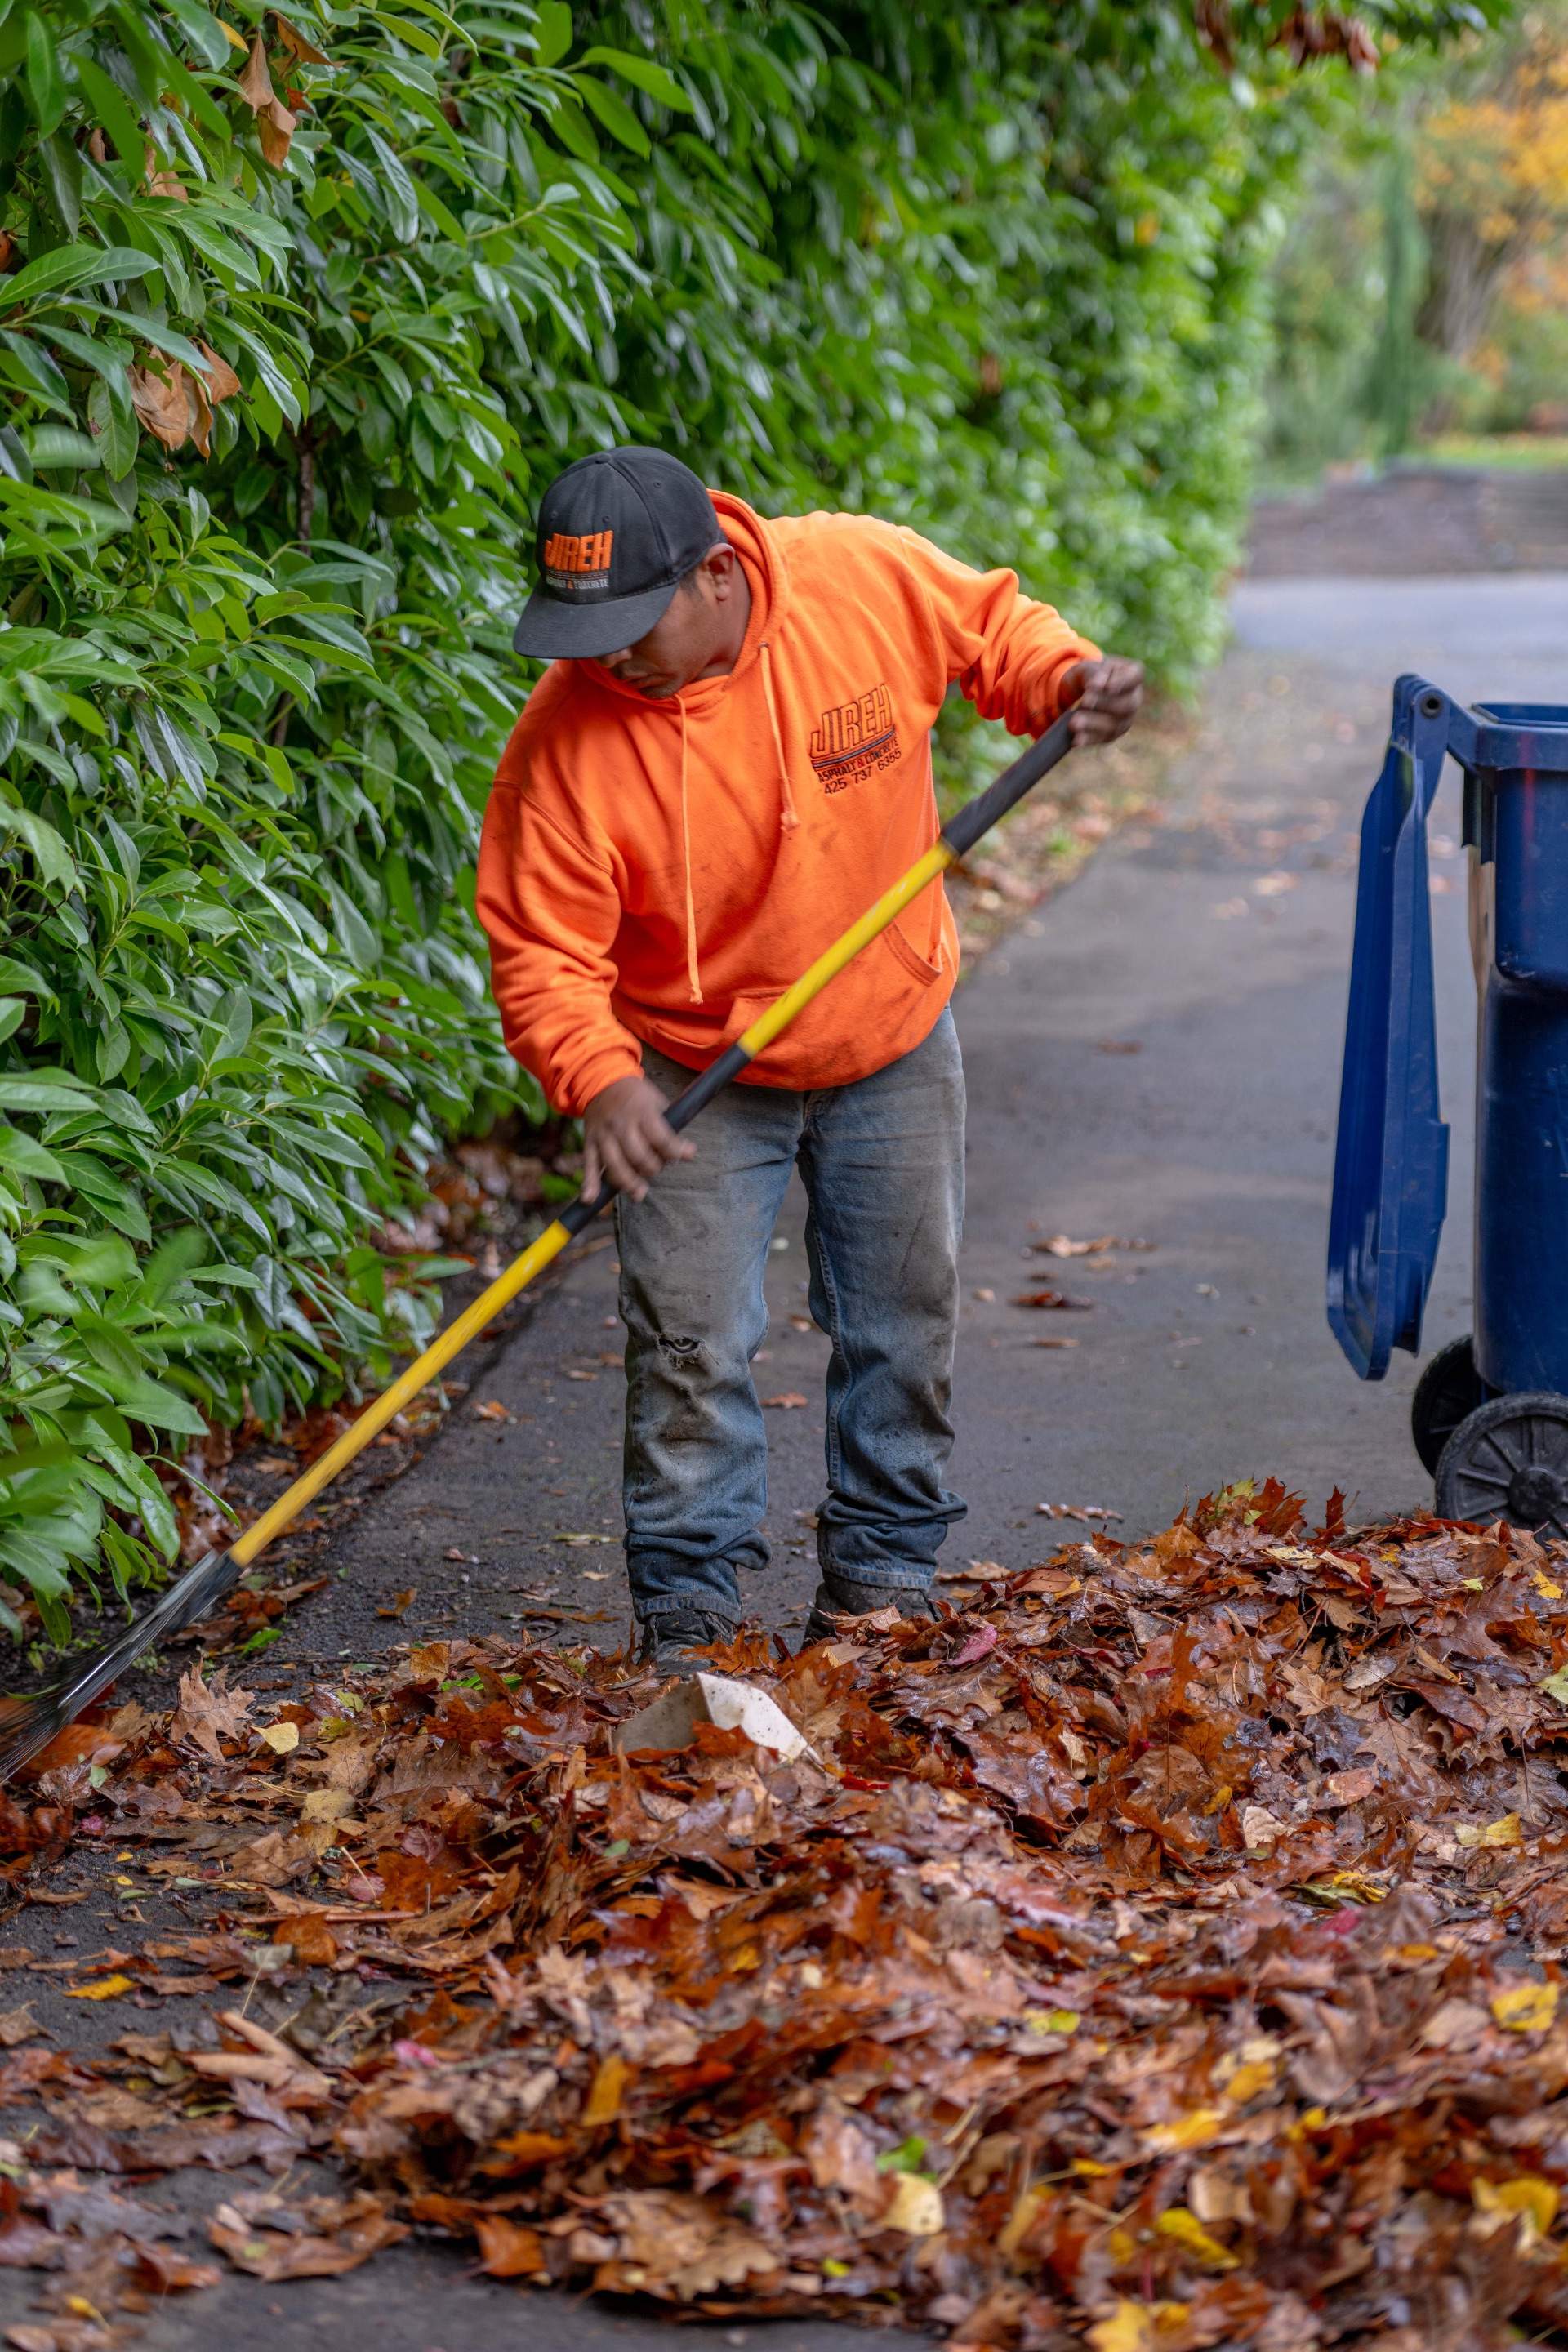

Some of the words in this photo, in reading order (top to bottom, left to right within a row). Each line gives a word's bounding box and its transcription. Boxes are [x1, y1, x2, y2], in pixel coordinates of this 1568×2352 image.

[543, 530, 613, 573] JIREH
[809, 683, 893, 759] JIREH
[817, 761, 856, 783] ASPHALT
[824, 777, 847, 794] 425
[851, 766, 872, 783] 737
